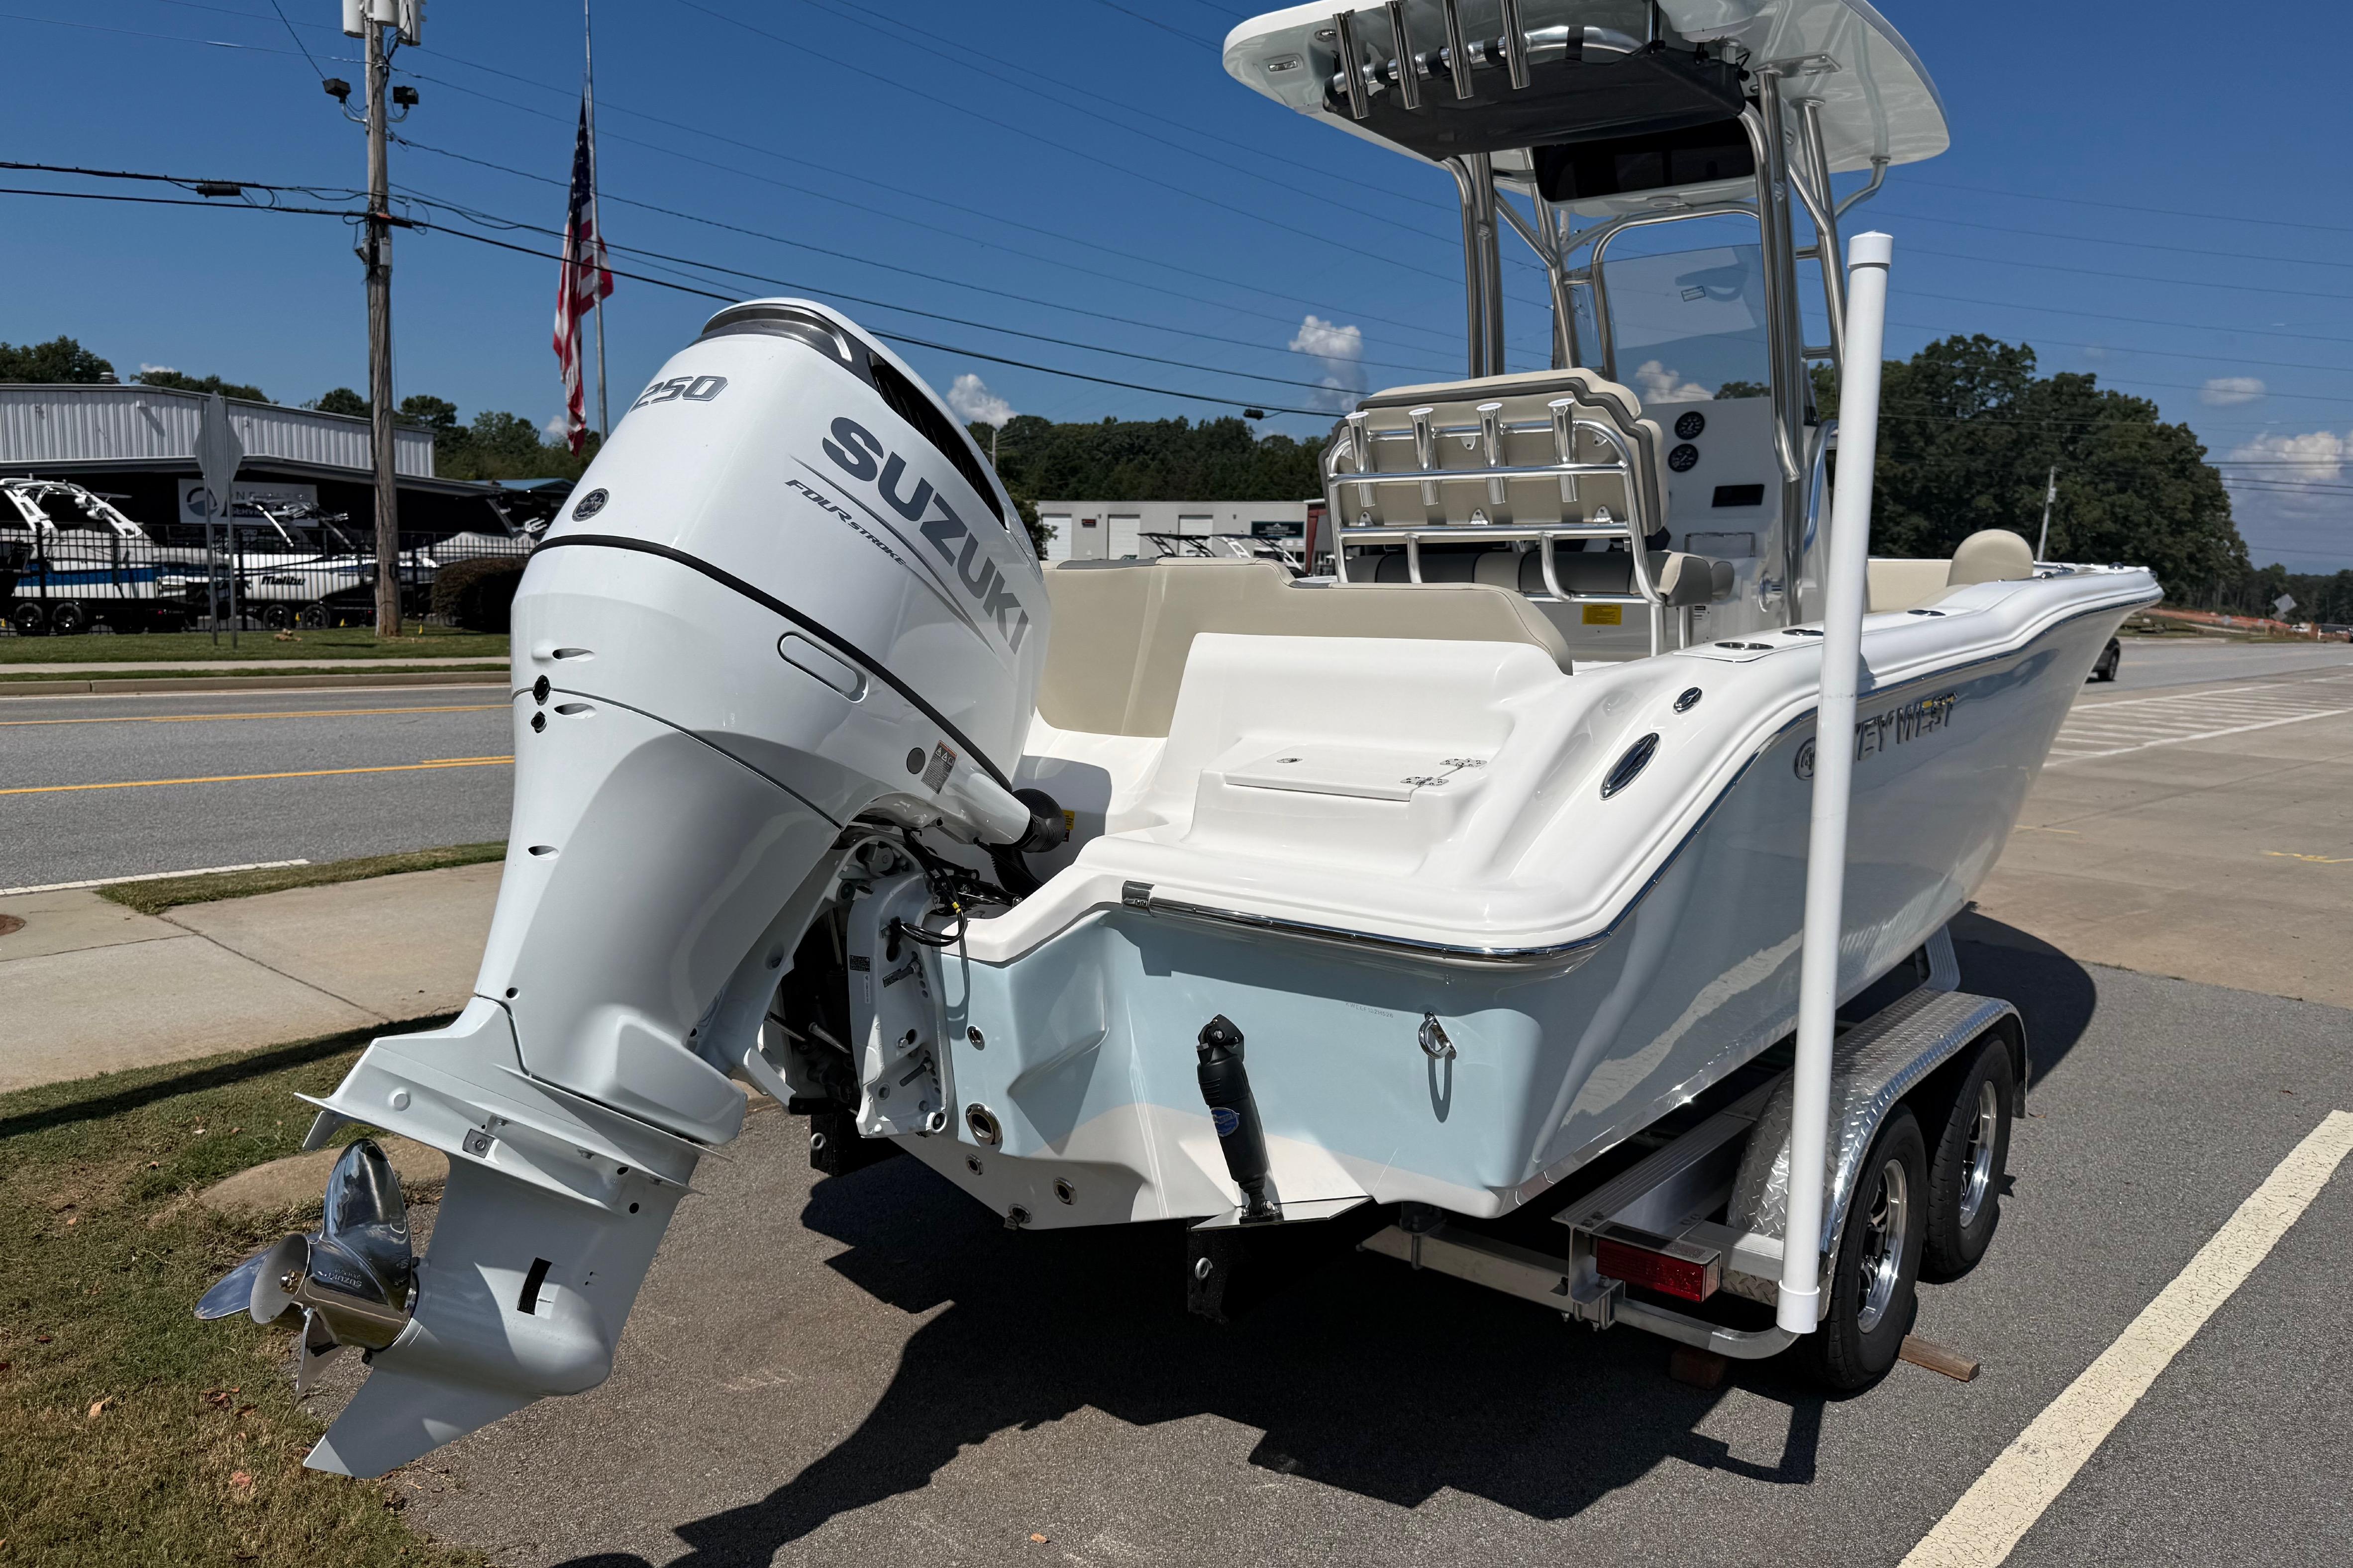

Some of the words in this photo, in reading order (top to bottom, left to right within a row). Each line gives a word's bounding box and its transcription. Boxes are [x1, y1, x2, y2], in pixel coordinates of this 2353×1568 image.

[629, 376, 728, 413] 250
[784, 479, 852, 523] FOUR
[848, 521, 907, 566] STROKE
[822, 416, 1029, 656] SUZUKI
[1855, 710, 1895, 761] EY
[1897, 691, 1958, 744] WEST
